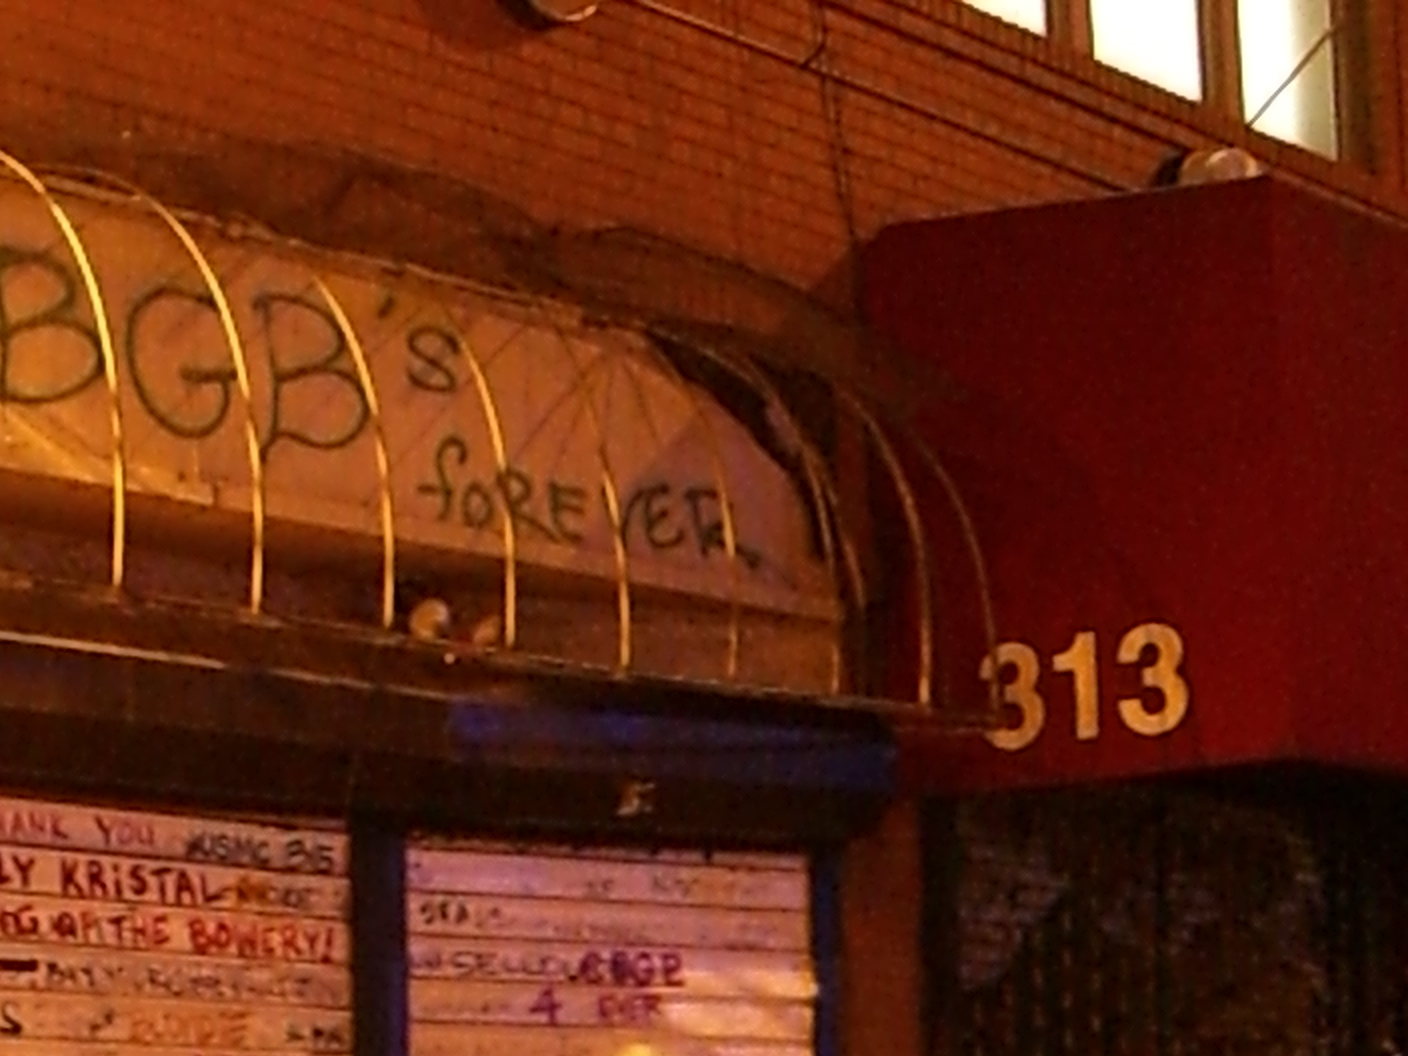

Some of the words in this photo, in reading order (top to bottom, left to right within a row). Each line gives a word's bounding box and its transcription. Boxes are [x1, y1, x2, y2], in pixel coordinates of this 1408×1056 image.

[979, 622, 1190, 750] 313
[97, 818, 156, 846] YOU
[107, 914, 170, 945] THE
[528, 987, 562, 1025] 4
